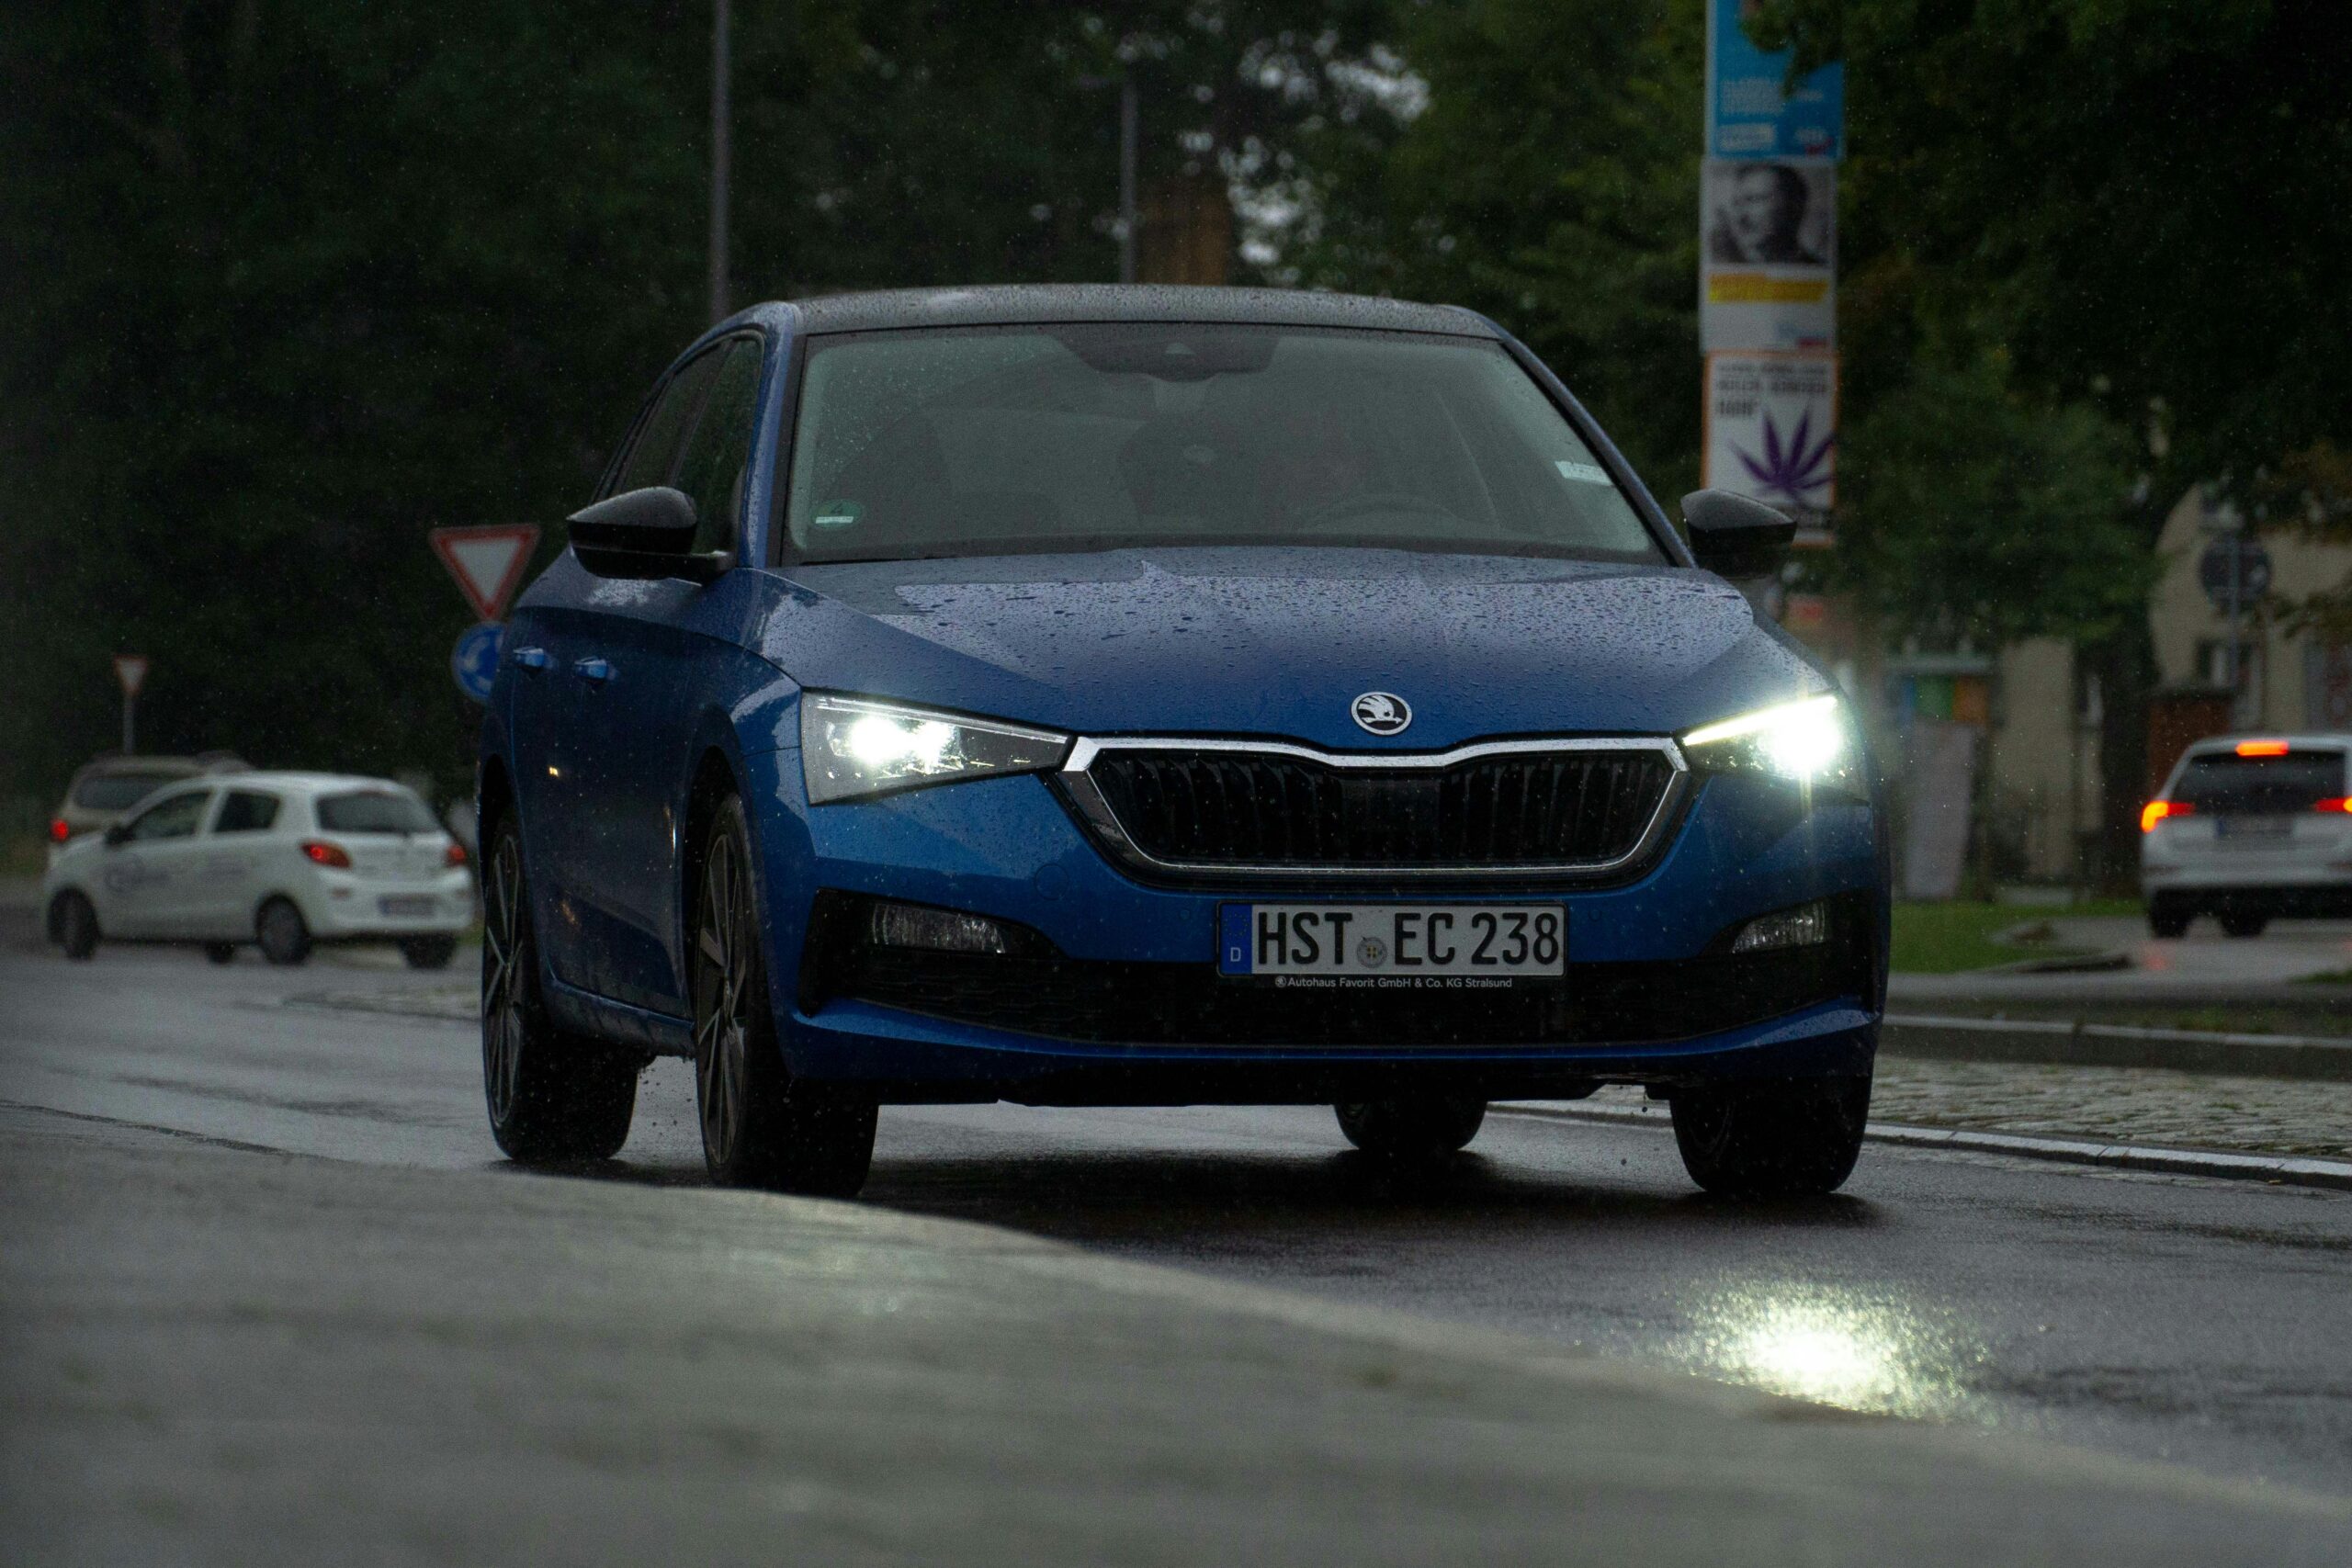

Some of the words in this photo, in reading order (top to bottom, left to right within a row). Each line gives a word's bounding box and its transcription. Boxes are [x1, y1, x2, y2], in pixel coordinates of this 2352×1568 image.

[1258, 911, 1353, 964] HST
[1394, 912, 1455, 965] EC
[1471, 912, 1560, 965] 238
[1229, 946, 1241, 963] D
[1287, 976, 1336, 987] Autohaus
[1340, 976, 1375, 987] Favorit
[1377, 976, 1411, 988] GmbH
[1414, 977, 1423, 988] &
[1425, 977, 1443, 988] Co.
[1446, 977, 1464, 988] KG
[1465, 977, 1513, 988] Stralsund
